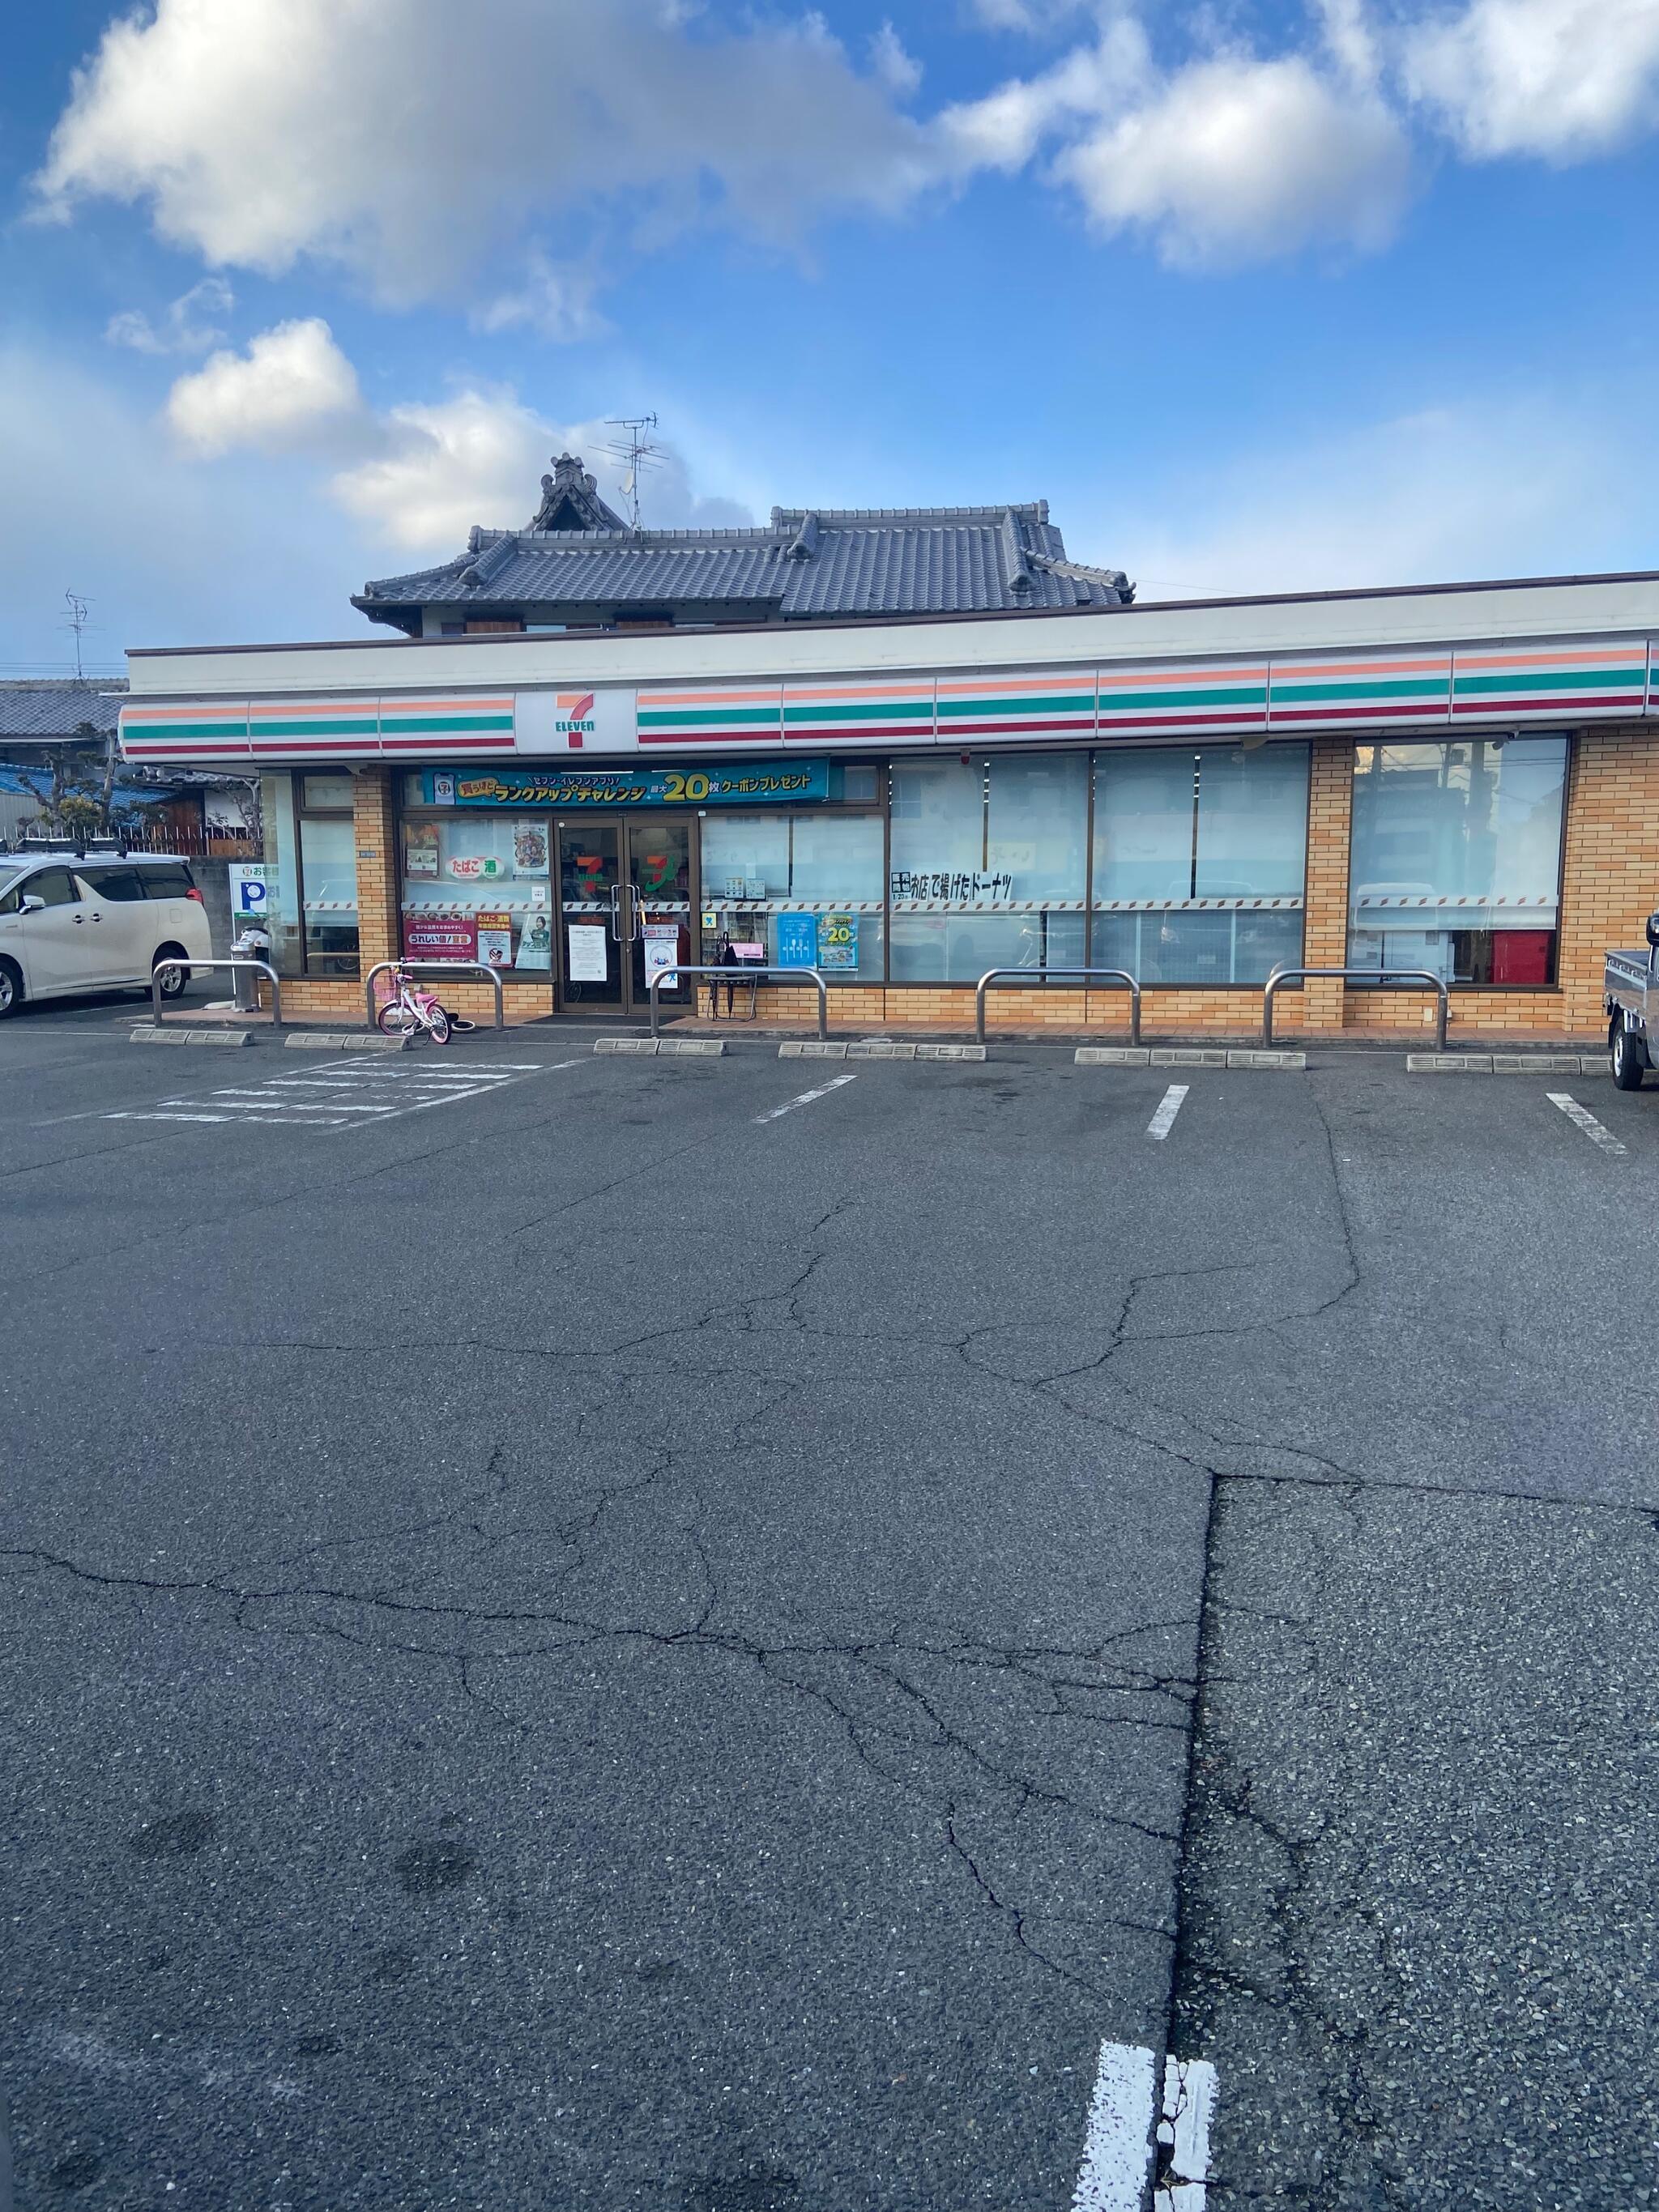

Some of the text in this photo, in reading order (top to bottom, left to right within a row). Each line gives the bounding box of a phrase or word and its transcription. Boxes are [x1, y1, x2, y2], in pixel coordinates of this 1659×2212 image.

[495, 785, 646, 802] ランクアップチャレンジ
[452, 859, 480, 873] たばこ
[484, 859, 497, 873] 酒
[911, 872, 1012, 901] お店で揚げたドーナツ
[241, 882, 266, 910] P
[828, 927, 850, 942] 20
